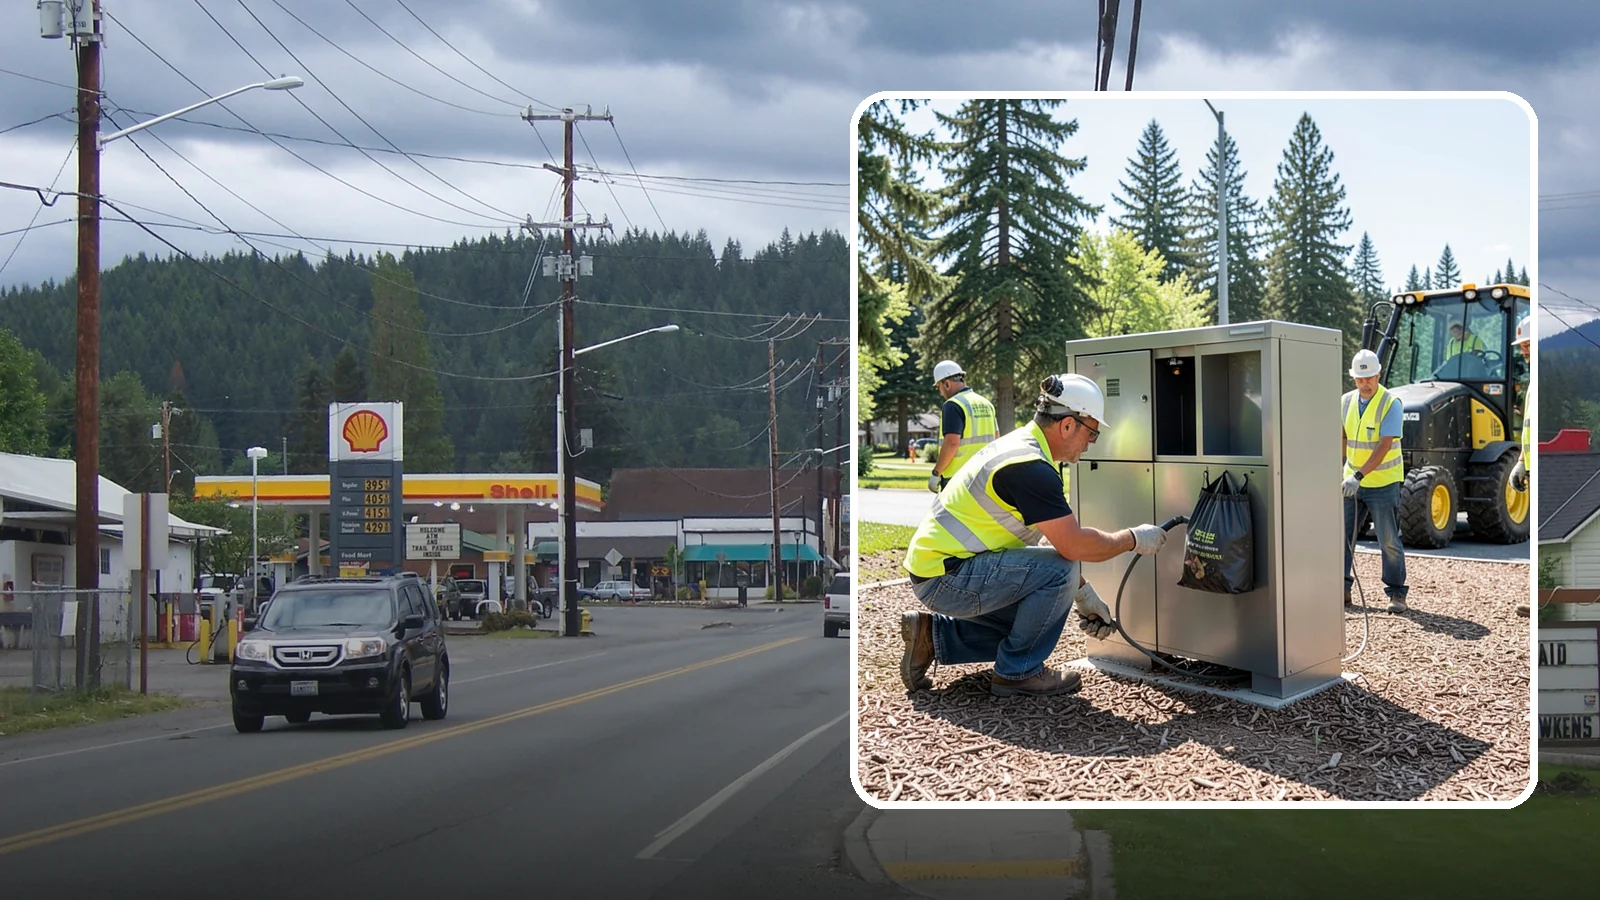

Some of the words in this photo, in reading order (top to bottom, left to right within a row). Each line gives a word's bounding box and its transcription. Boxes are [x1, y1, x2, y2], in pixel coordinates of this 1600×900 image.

[365, 480, 383, 490] 395
[490, 484, 547, 499] Shell
[365, 494, 383, 504] 405
[365, 508, 383, 518] 415
[365, 522, 383, 532] 429
[1538, 643, 1567, 666] AID
